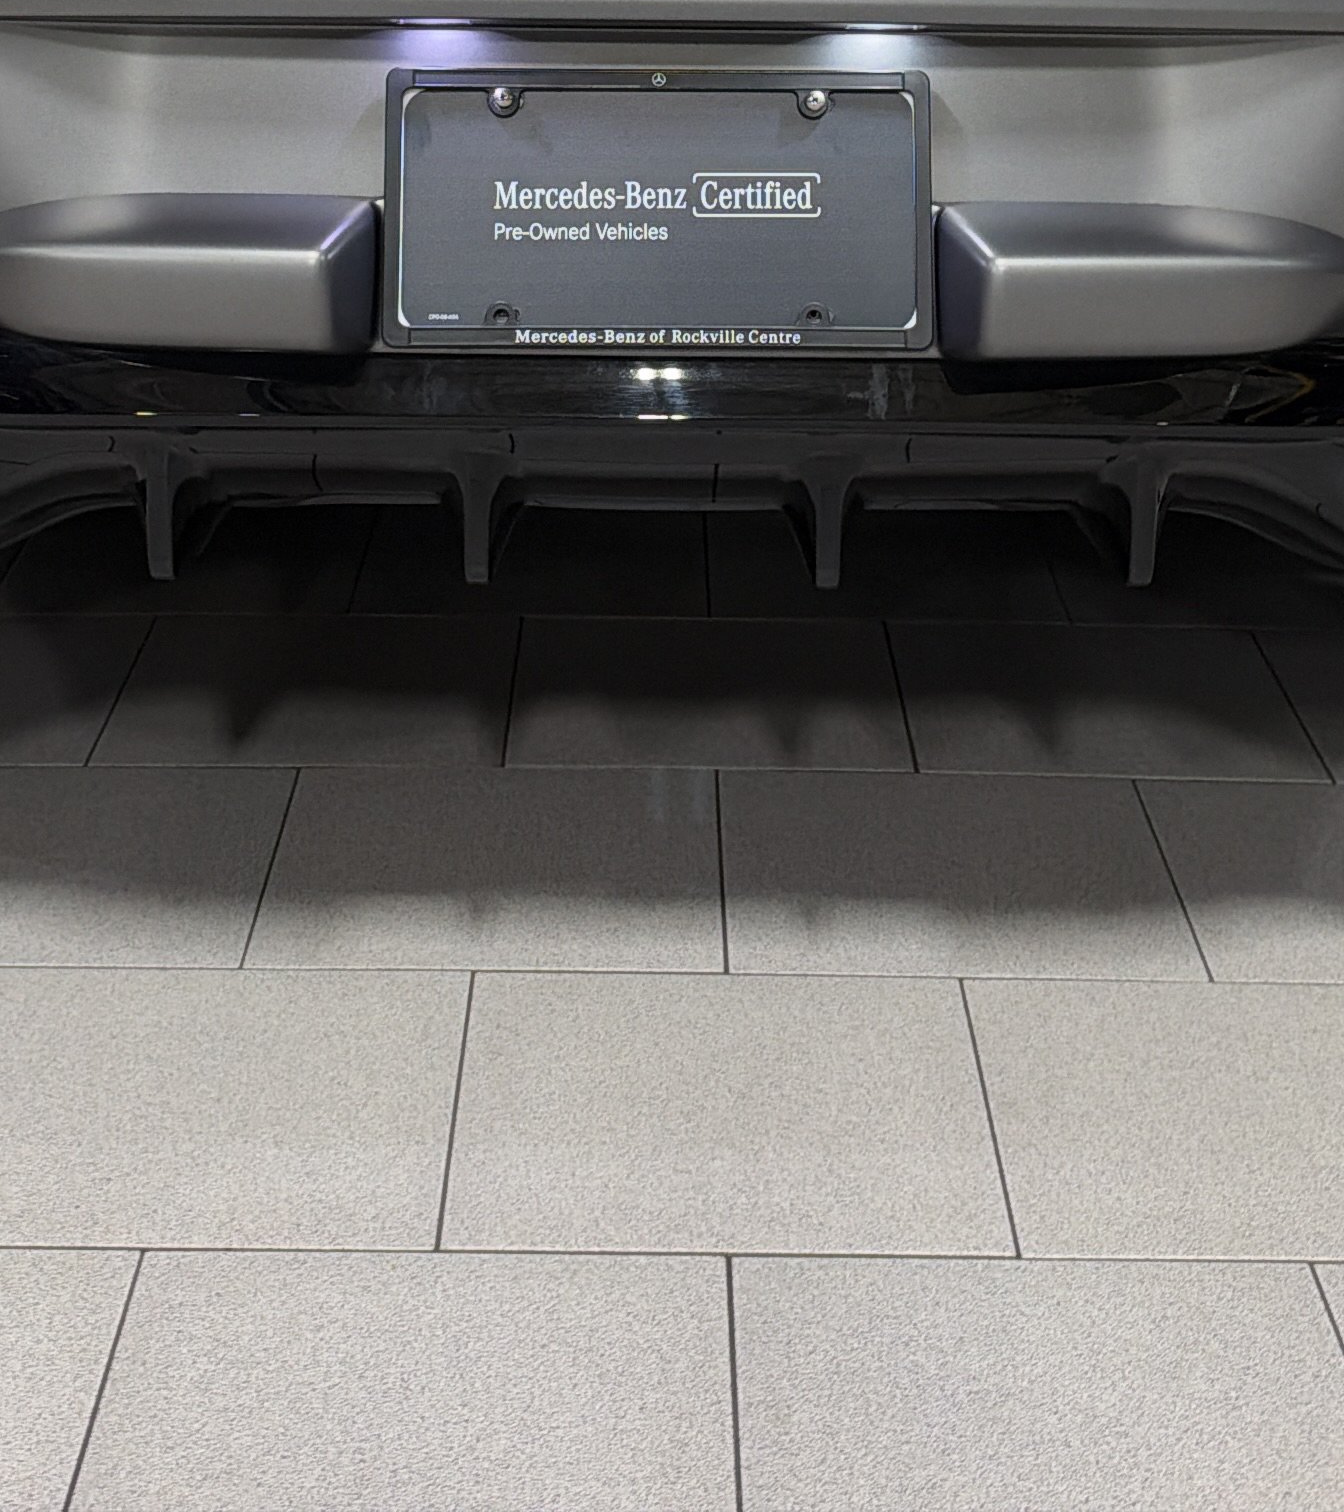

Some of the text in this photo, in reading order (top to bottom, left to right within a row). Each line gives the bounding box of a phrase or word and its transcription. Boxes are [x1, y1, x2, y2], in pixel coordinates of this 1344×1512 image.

[493, 180, 813, 210] Mercedes-Benz Certified
[494, 222, 668, 240] Pre-Owned Vehicles
[515, 329, 801, 345] Mercedes-Benz of Rockville Centre
